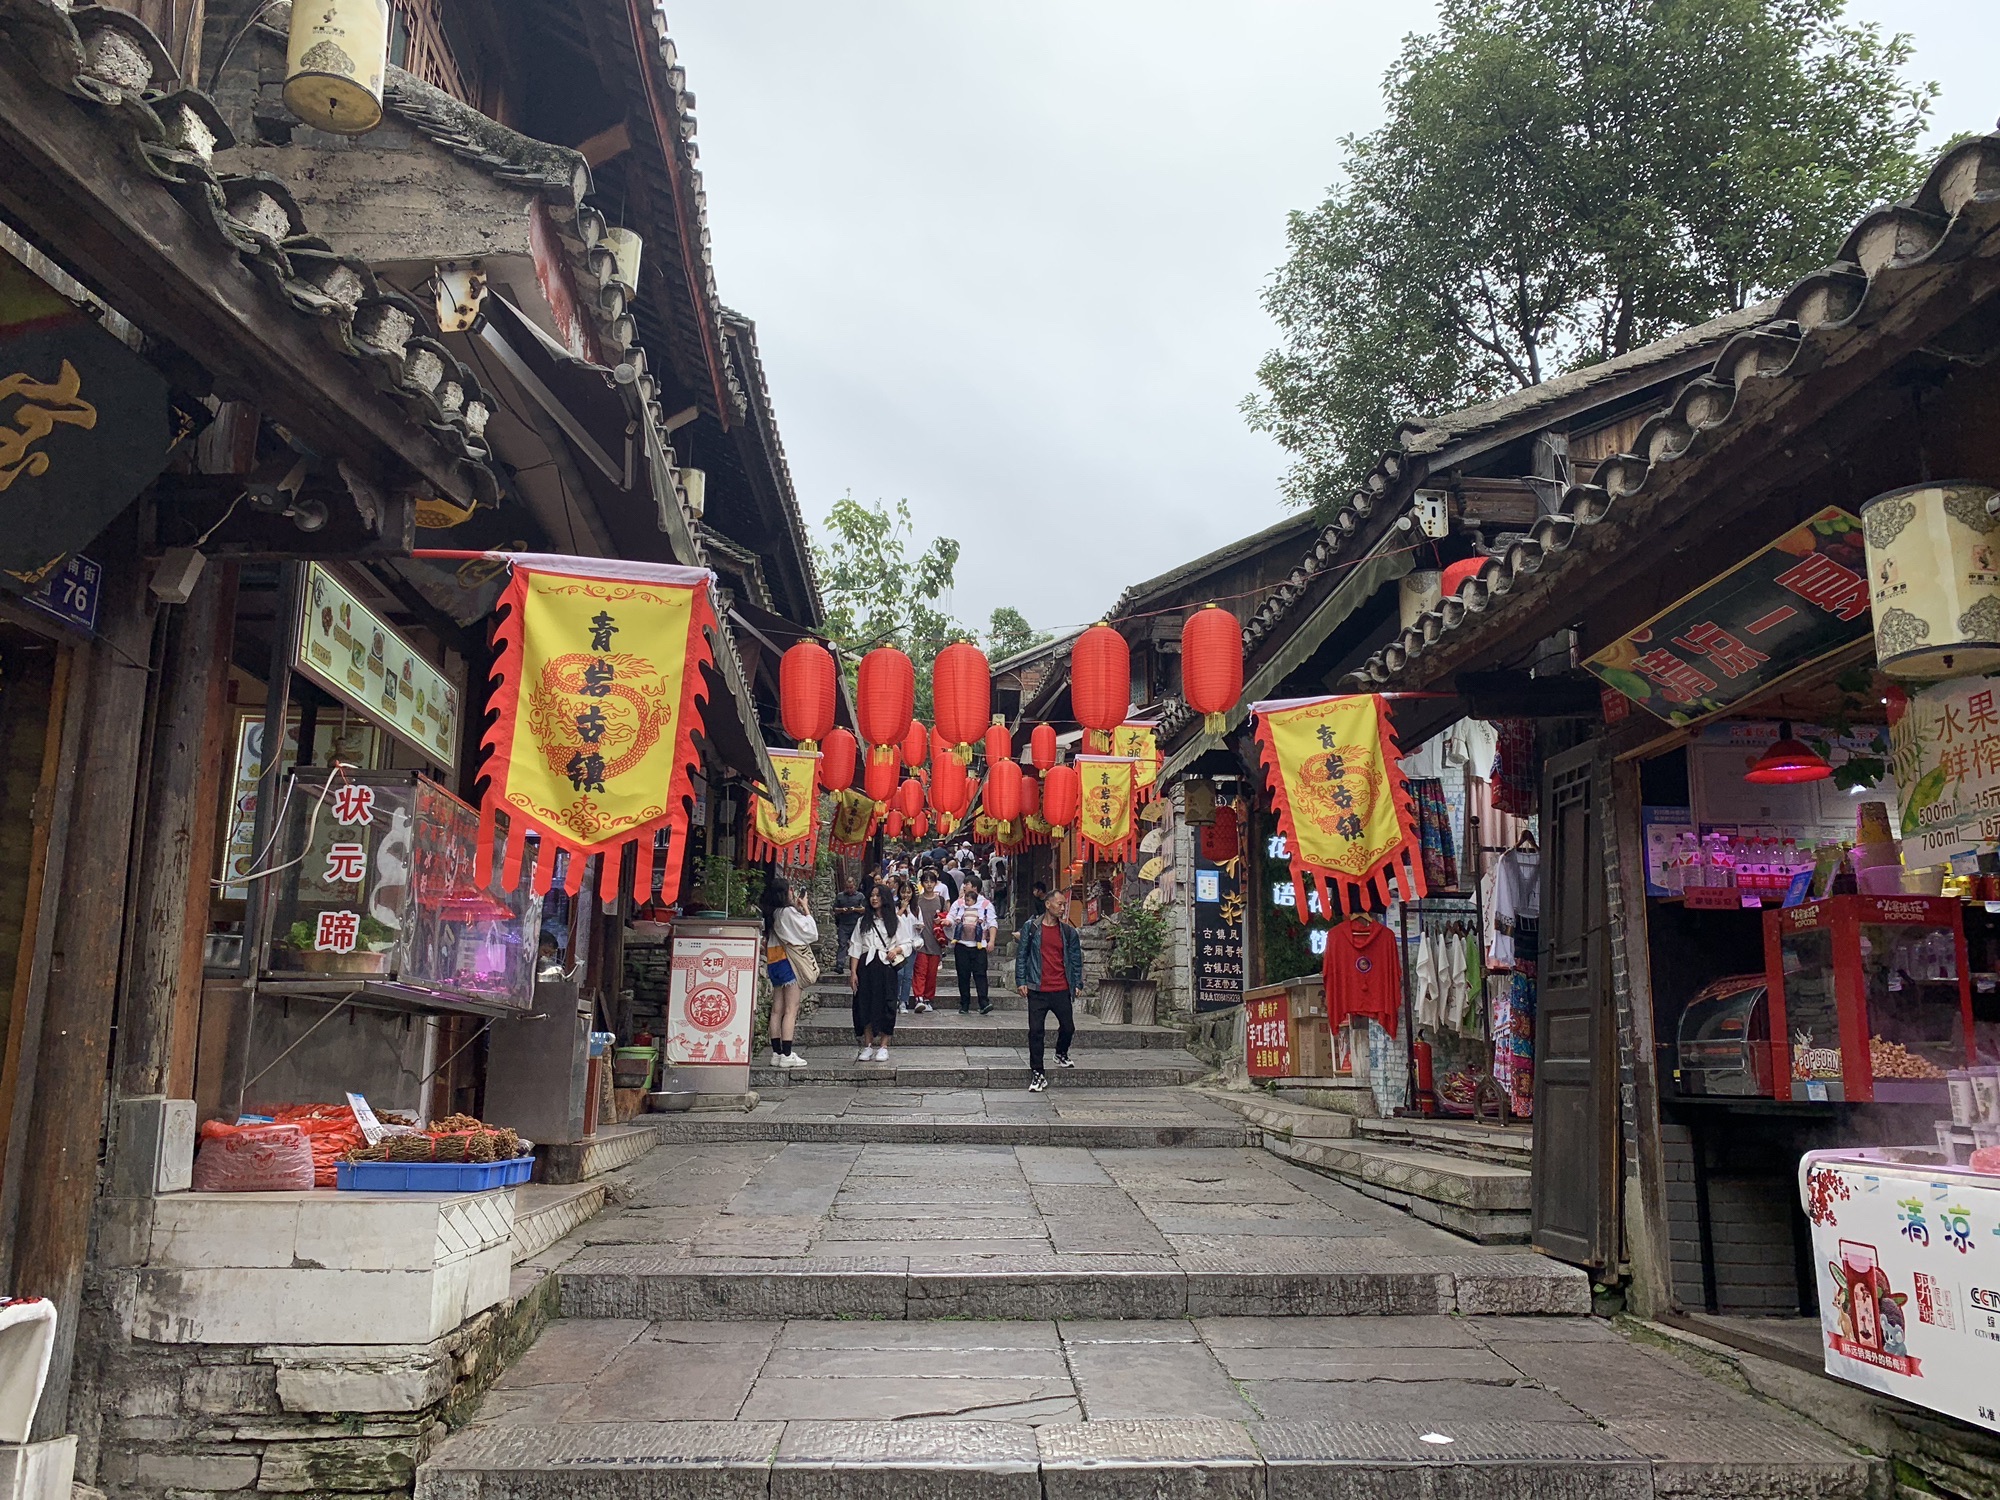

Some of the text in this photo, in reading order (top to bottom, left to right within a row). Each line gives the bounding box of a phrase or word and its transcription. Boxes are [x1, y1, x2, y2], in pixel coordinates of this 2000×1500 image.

[63, 578, 88, 611] 76
[566, 610, 619, 794] 青岩古镇
[1934, 690, 1999, 744] 水果
[1316, 724, 1366, 842] 青岩古镇
[1100, 772, 1112, 829] 青岩古镇
[1918, 800, 1958, 825] 500ml
[1921, 826, 1961, 851] 700ml
[316, 787, 373, 953] 状元蹄
[1884, 913, 1925, 921] POPCORN
[703, 957, 724, 968] 文明
[1203, 962, 1243, 975] 古镇风味
[1205, 979, 1239, 990] 正在营业
[1249, 1020, 1286, 1049] 手工鲜花饼
[1256, 1050, 1279, 1067] 全国包邮
[1799, 1049, 1840, 1072] POPCORN
[1897, 1196, 2000, 1255] 清凉
